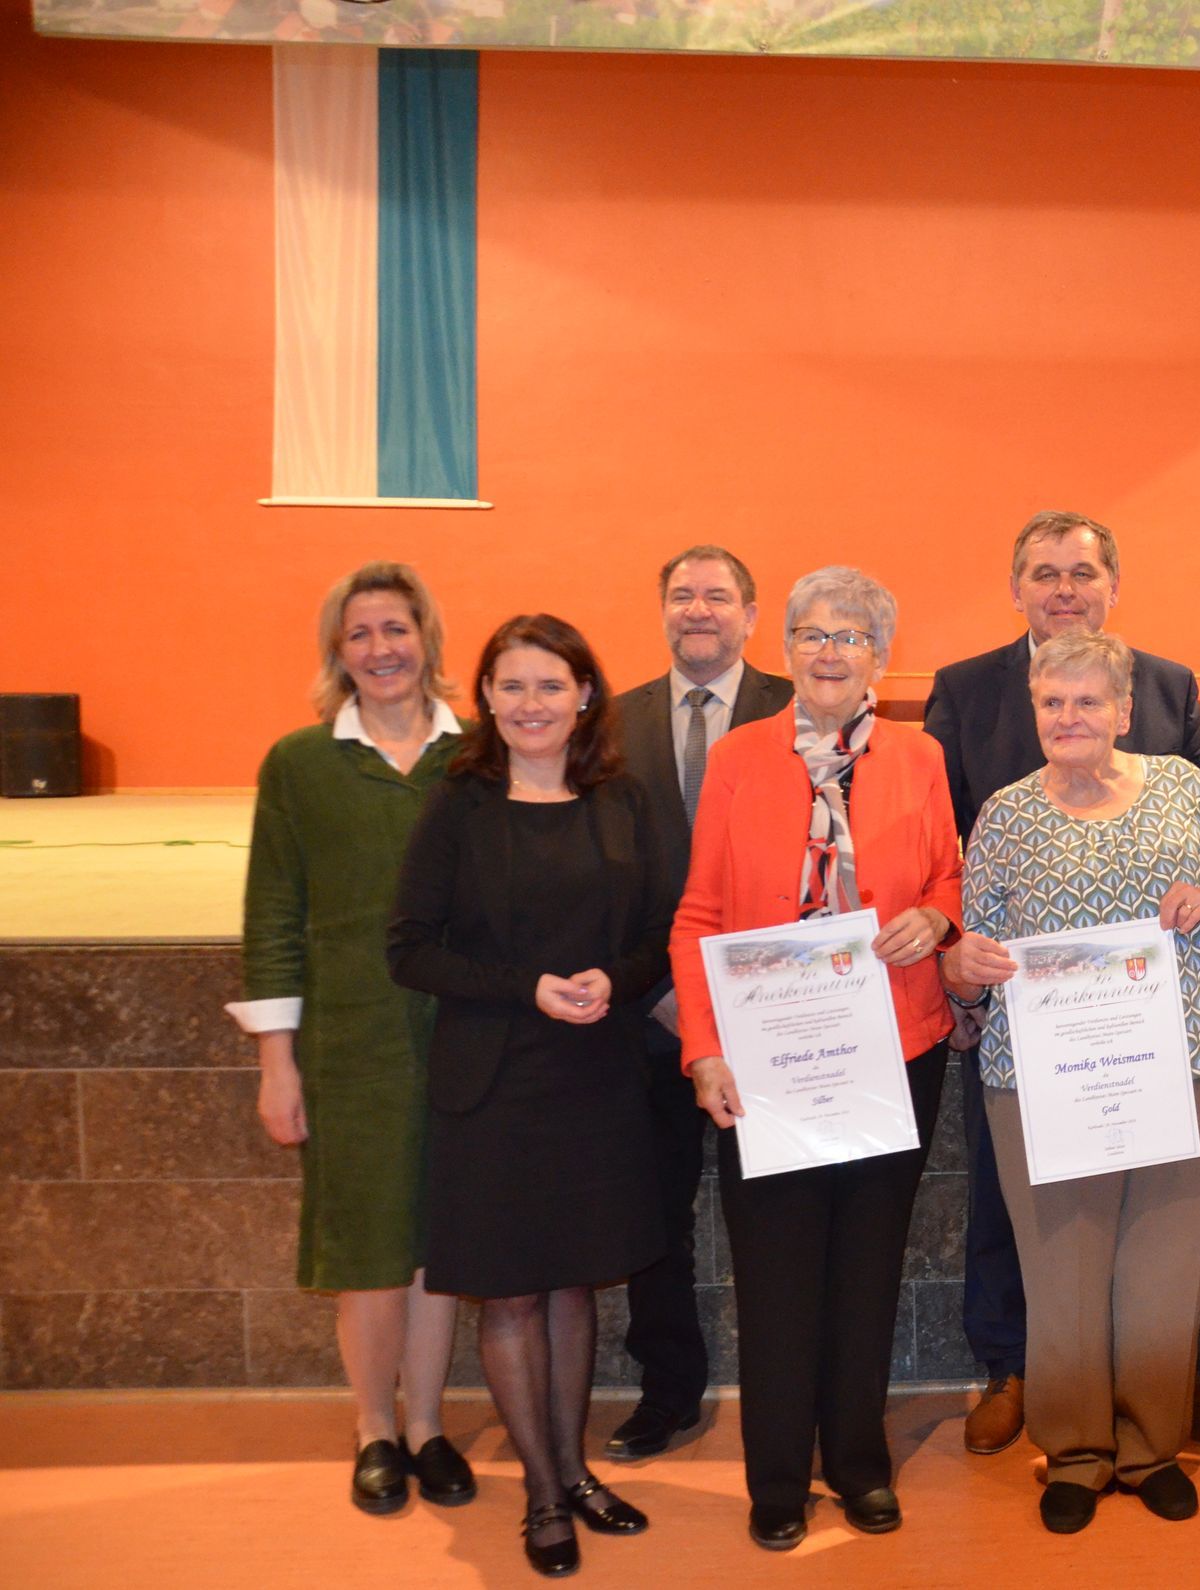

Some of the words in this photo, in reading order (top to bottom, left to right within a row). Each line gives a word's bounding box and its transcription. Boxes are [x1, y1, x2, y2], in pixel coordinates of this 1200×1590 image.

[770, 1048, 815, 1068] Elfriede
[816, 1043, 858, 1061] Amthor
[1054, 1057, 1097, 1075] Monika
[1099, 1051, 1155, 1068] Weismann
[1101, 1102, 1120, 1116] Gold
